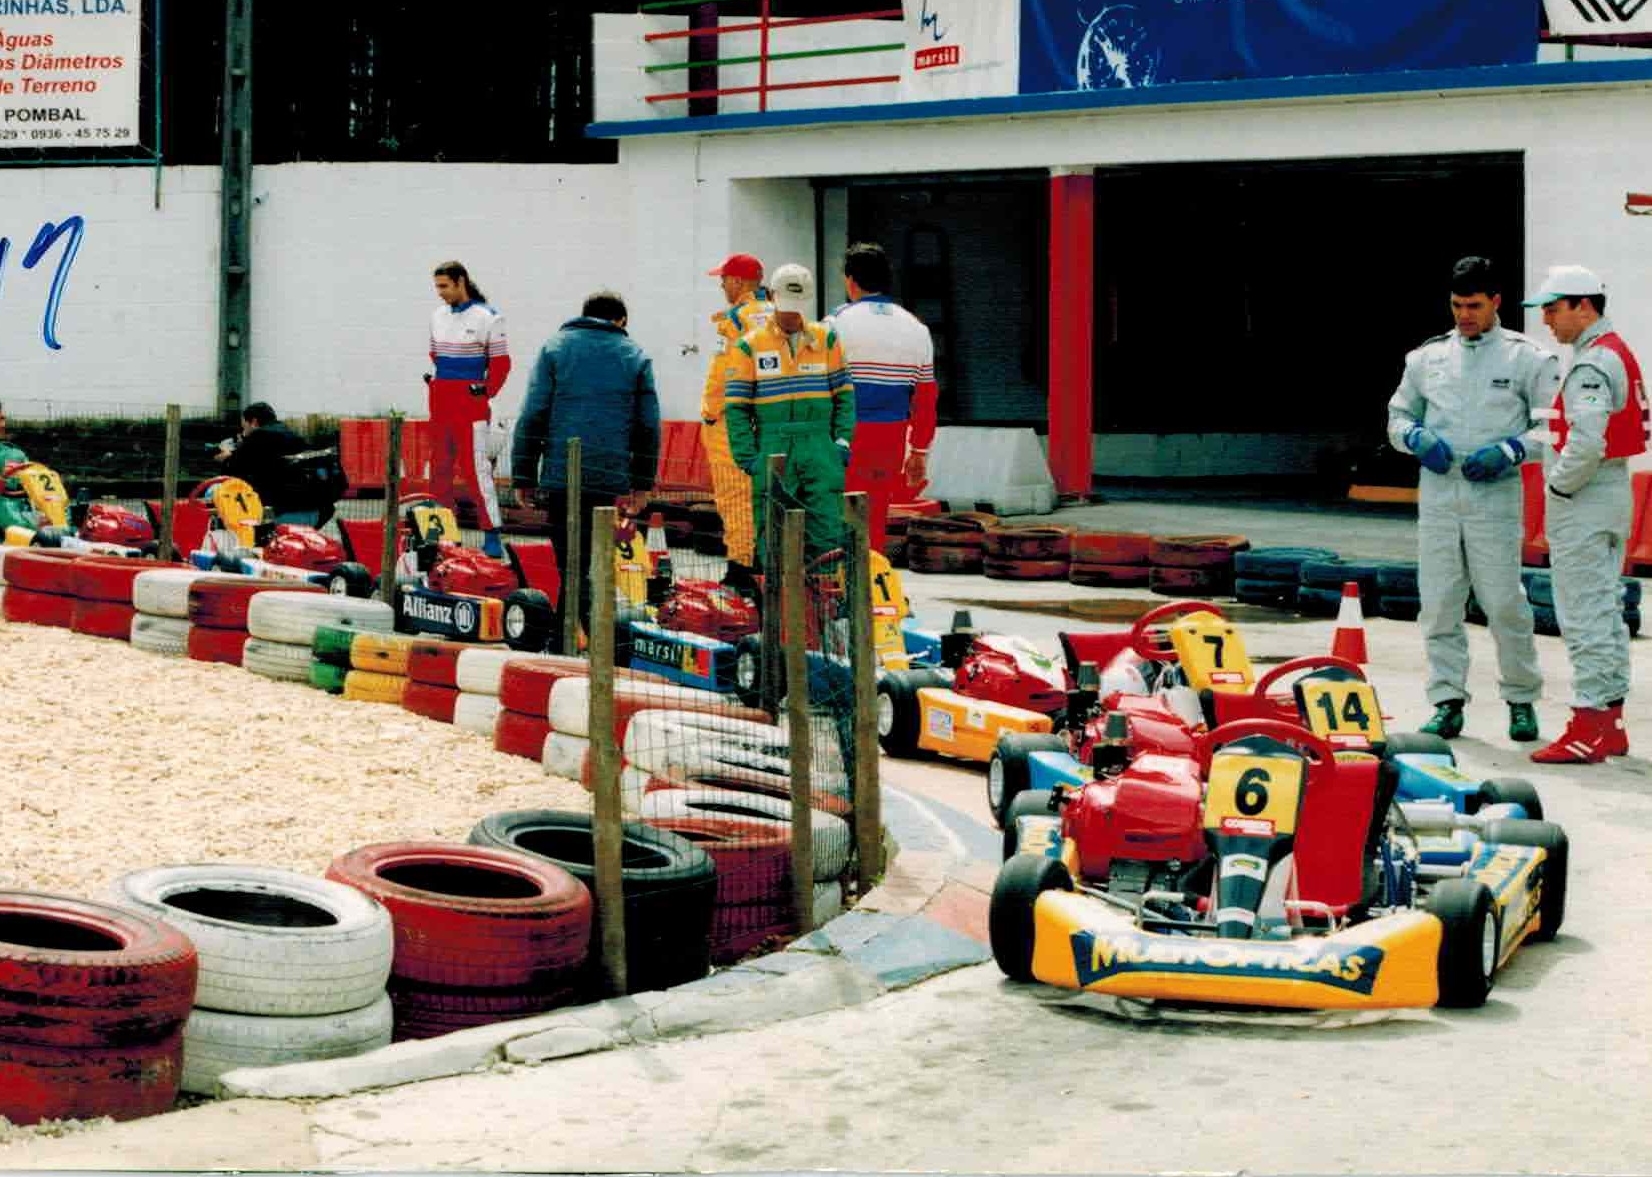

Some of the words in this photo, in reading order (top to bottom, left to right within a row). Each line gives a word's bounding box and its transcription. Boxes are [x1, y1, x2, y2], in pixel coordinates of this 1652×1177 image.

[0, 0, 75, 16] INHAS,
[21, 53, 123, 70] Diâmetros
[916, 47, 957, 67] marsil
[21, 77, 97, 93] Terreno
[4, 108, 86, 122] POMBAL
[75, 129, 91, 138] 45
[114, 128, 130, 138] 29
[38, 474, 56, 492] 2
[428, 514, 446, 534] 3
[403, 595, 452, 625] Allianz
[1203, 634, 1224, 669] 7
[1316, 691, 1370, 731] 14
[1234, 767, 1272, 816] 6
